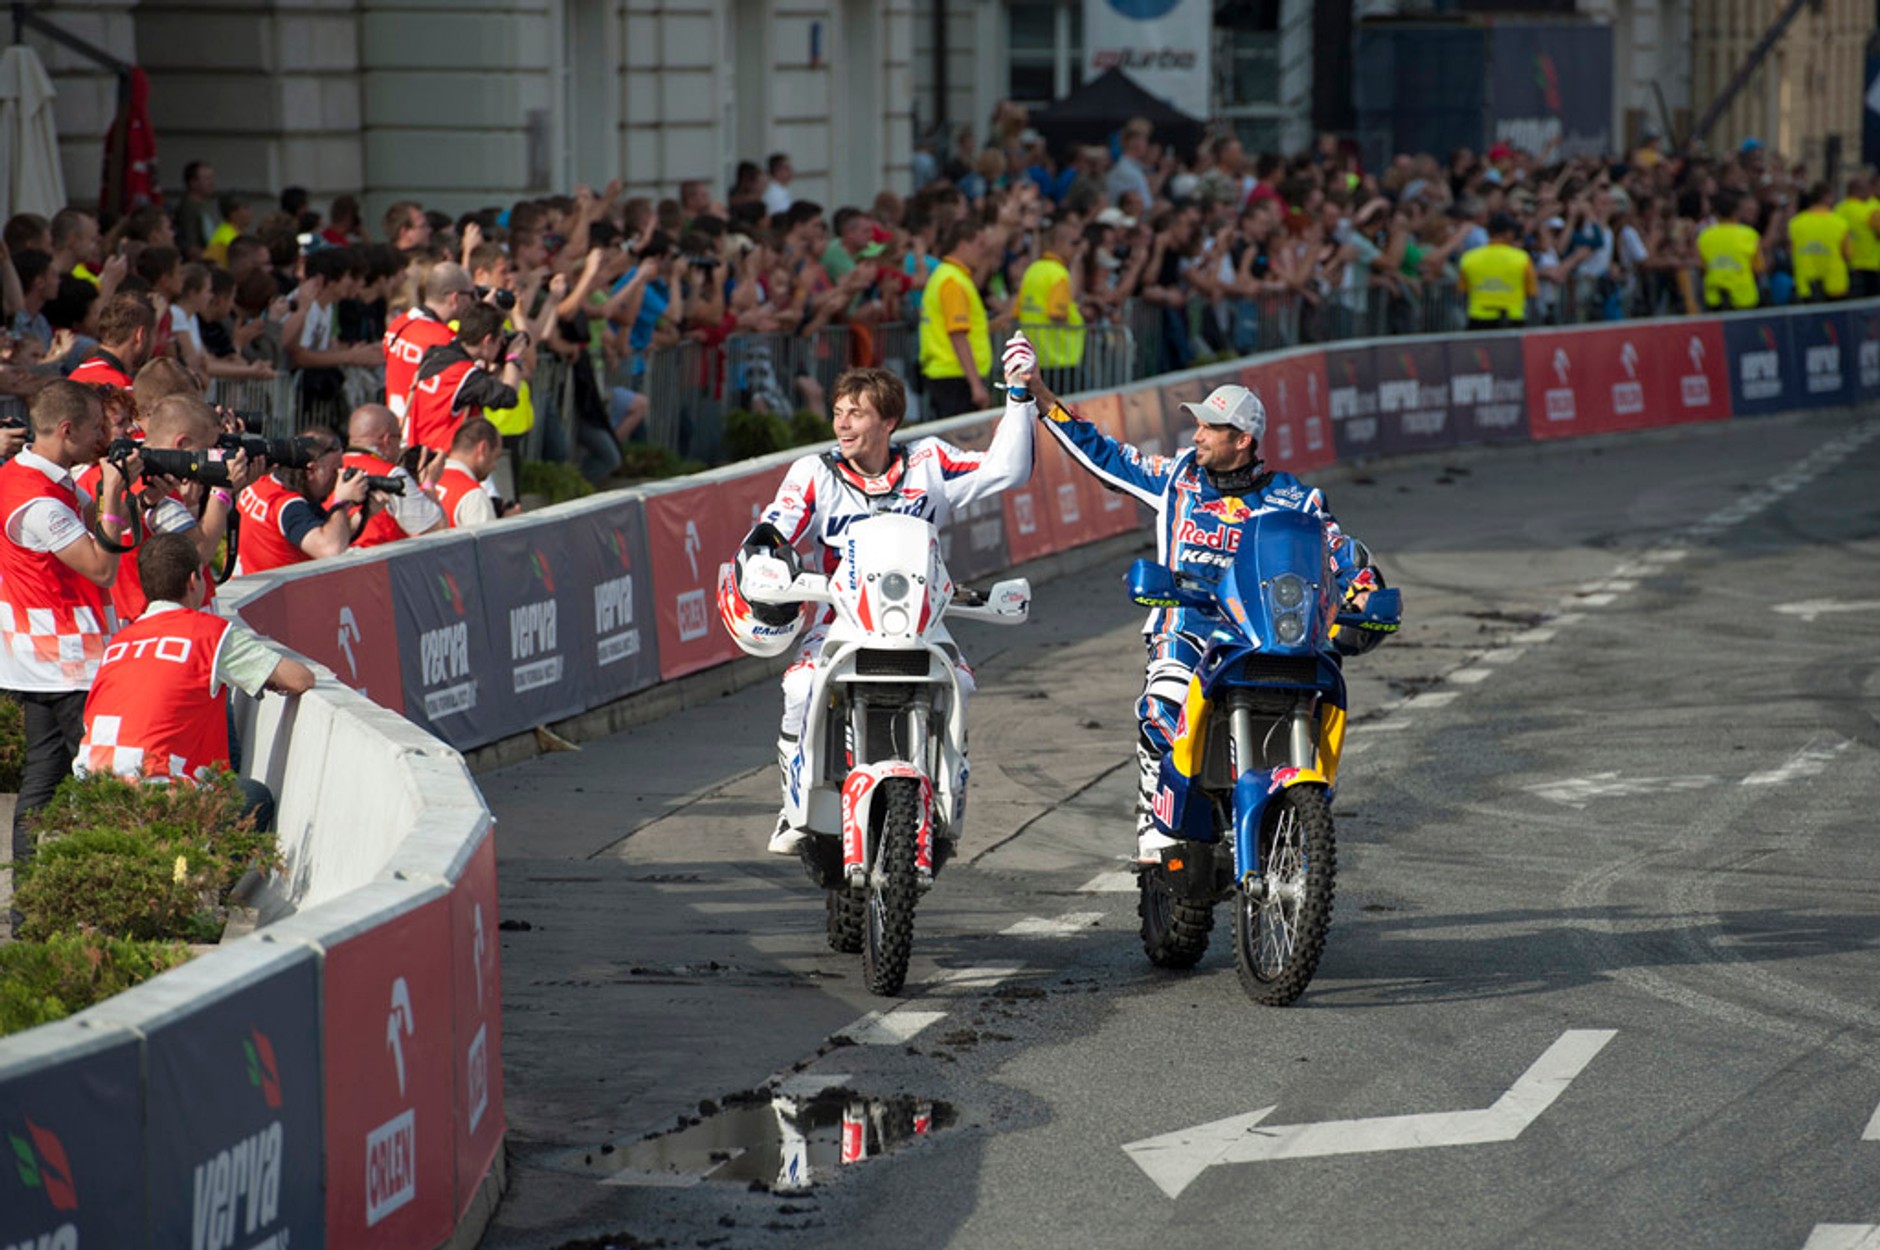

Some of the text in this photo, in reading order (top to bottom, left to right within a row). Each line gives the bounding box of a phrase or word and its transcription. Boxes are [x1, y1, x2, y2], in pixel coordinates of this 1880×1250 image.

[1178, 519, 1226, 549] Red
[101, 636, 192, 667] OTO
[420, 621, 469, 687] verva
[510, 599, 557, 660] verva
[1152, 785, 1174, 829] ull
[192, 1121, 283, 1250] verva
[368, 1118, 413, 1212] ORLEN
